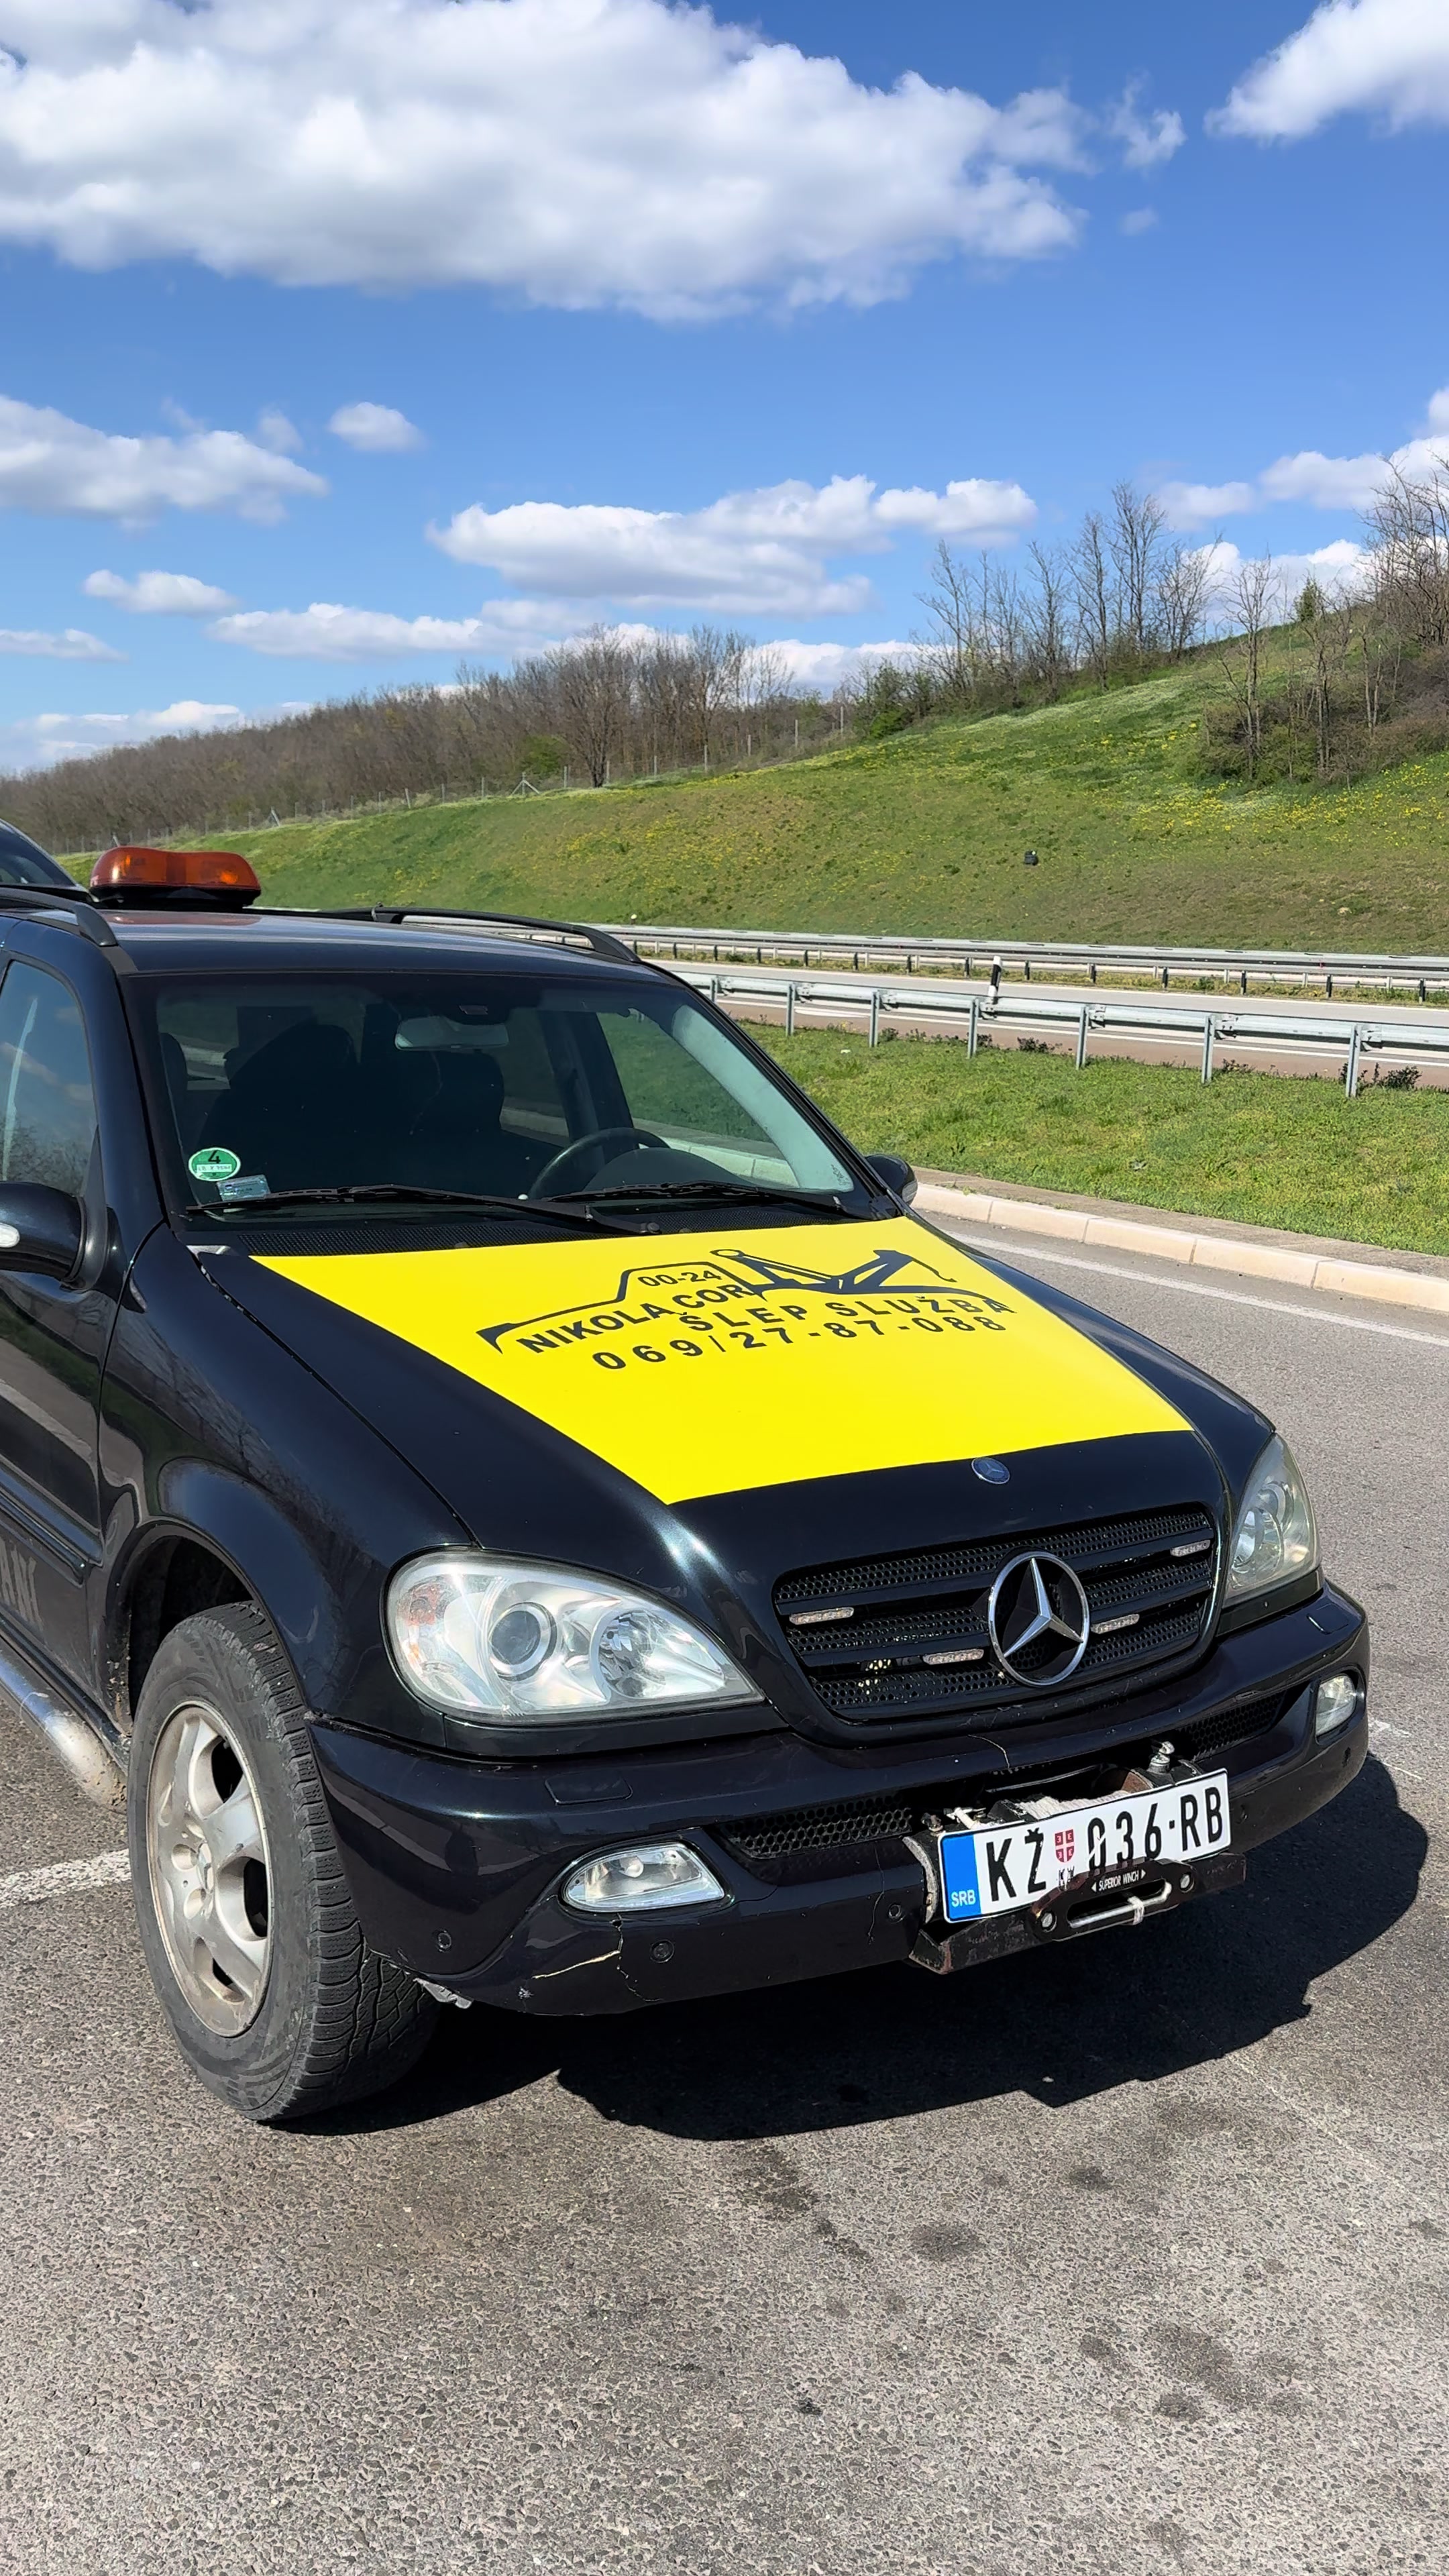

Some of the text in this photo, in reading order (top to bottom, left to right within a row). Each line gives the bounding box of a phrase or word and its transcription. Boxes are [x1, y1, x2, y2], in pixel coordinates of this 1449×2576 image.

[208, 1150, 221, 1163] 4
[637, 1270, 722, 1287] 00-24
[676, 1295, 1017, 1331] ŠLEP SLUŽBA
[516, 1303, 678, 1354] NIKOLA
[592, 1316, 1006, 1369] 069/27-87-088
[986, 1827, 1046, 1902] KŽ
[1099, 1870, 1139, 1891] SUPERIOR WINCH
[951, 1889, 976, 1907] SRB
